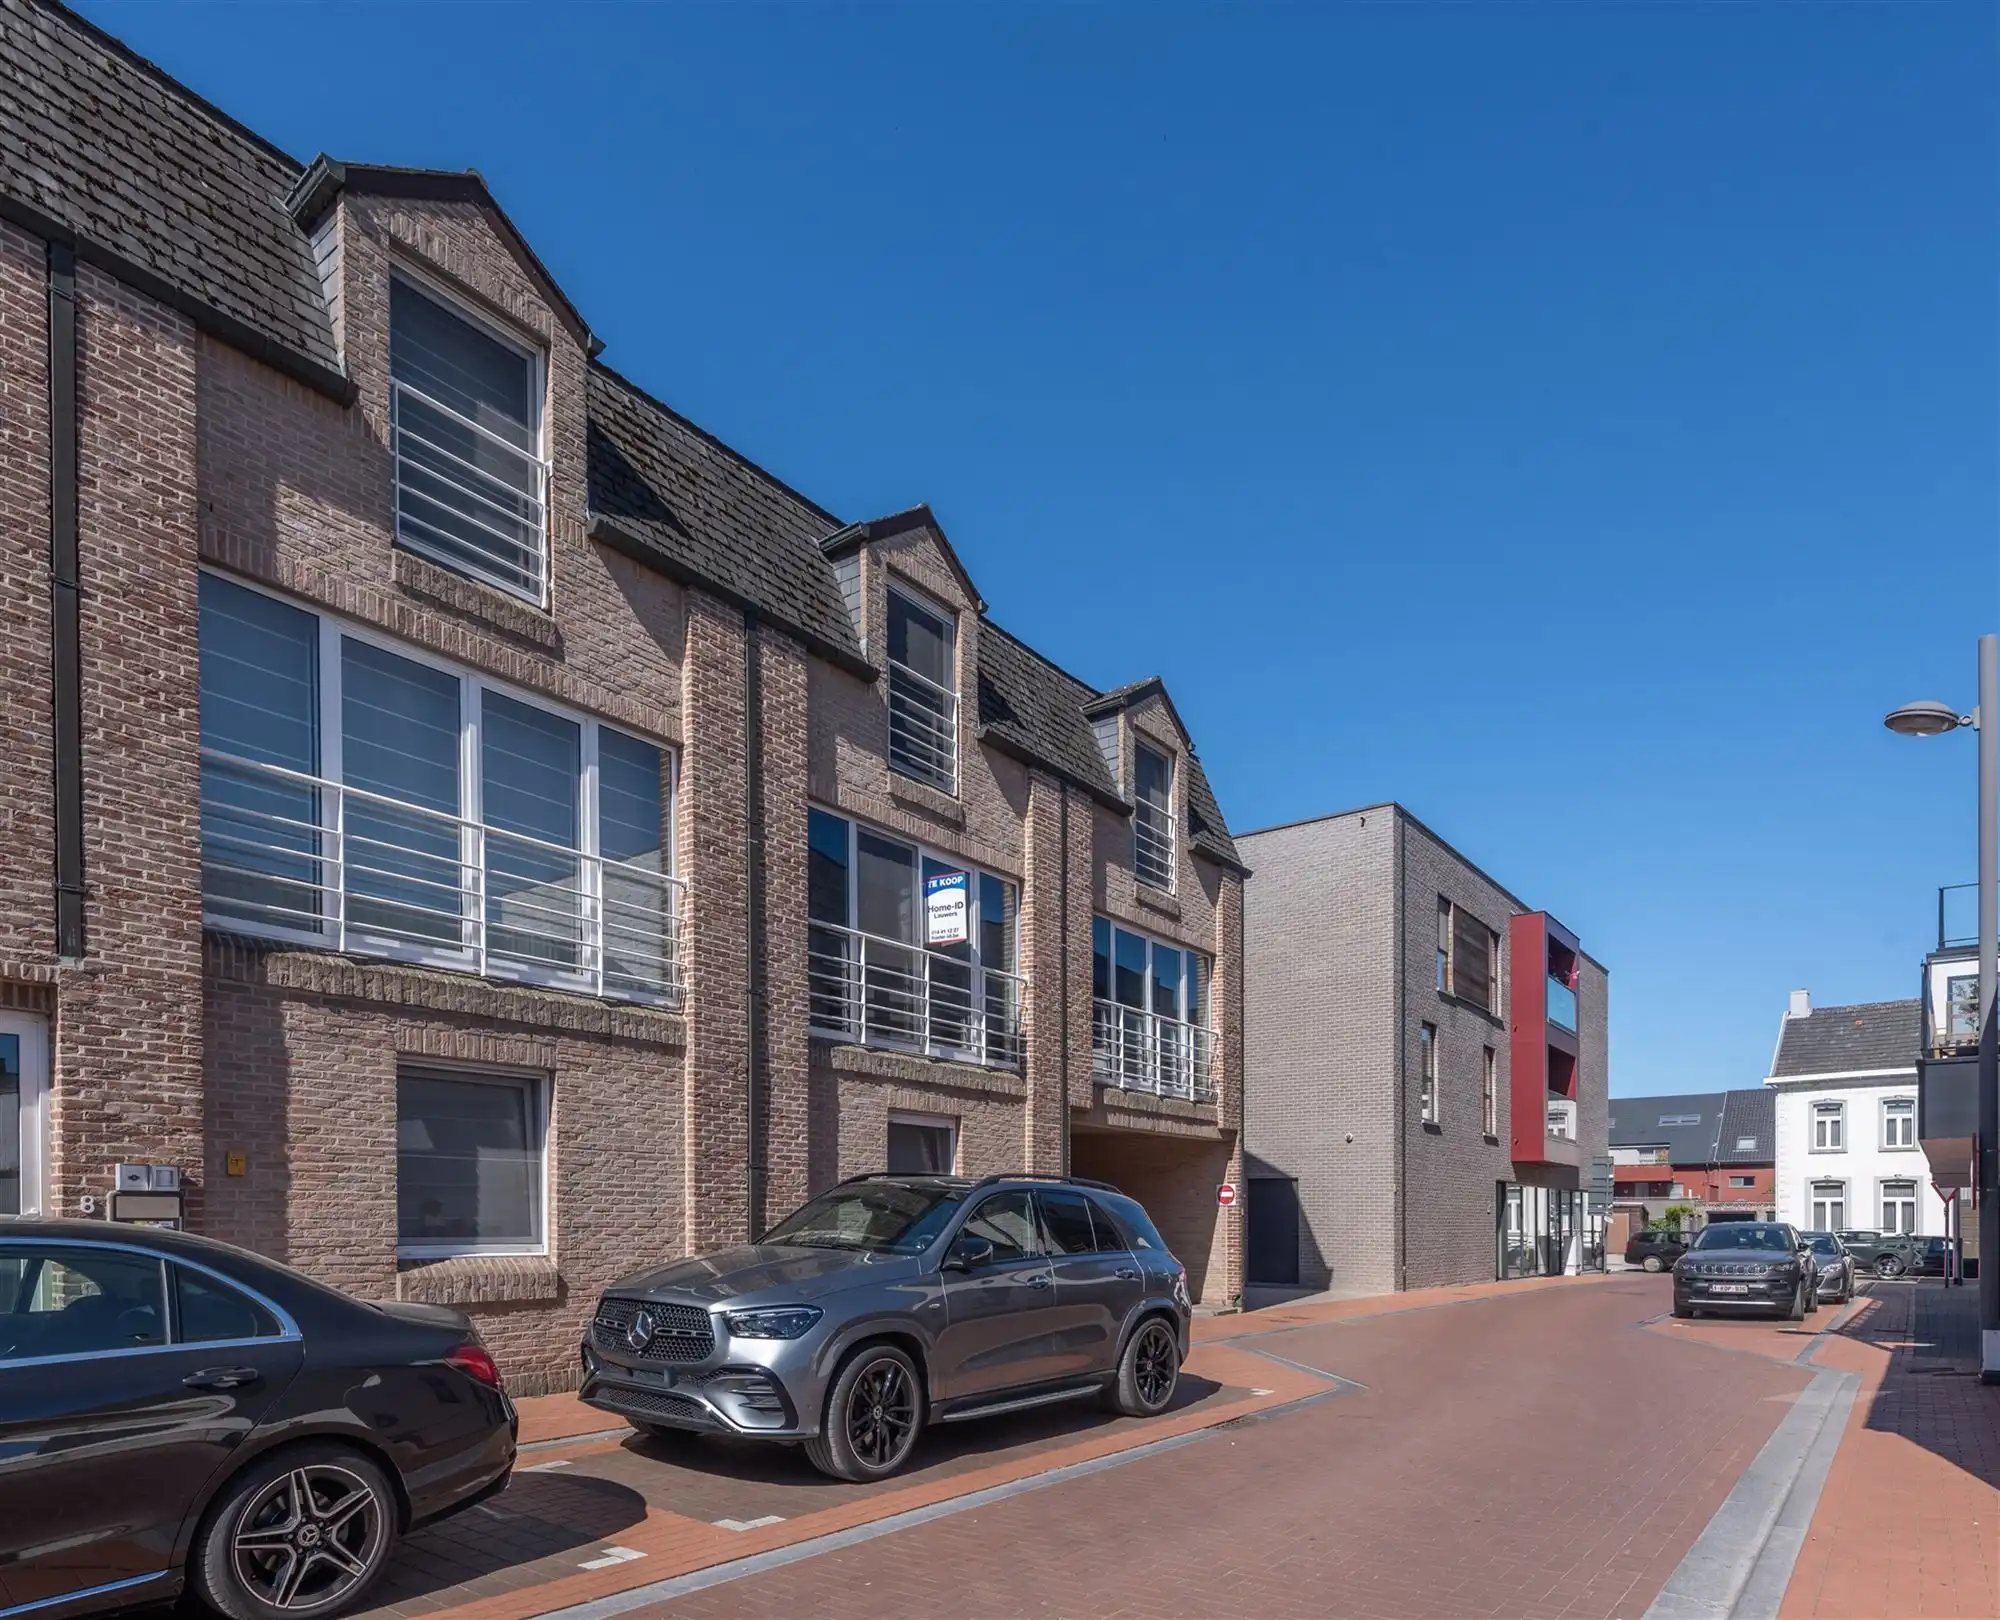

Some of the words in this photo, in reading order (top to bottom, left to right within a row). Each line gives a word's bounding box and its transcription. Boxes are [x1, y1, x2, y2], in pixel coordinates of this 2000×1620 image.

[928, 879, 938, 888] TE
[940, 876, 963, 887] KOOP
[928, 901, 964, 913] Home-ID
[934, 911, 958, 919] Lauwers
[80, 1195, 95, 1214] 8
